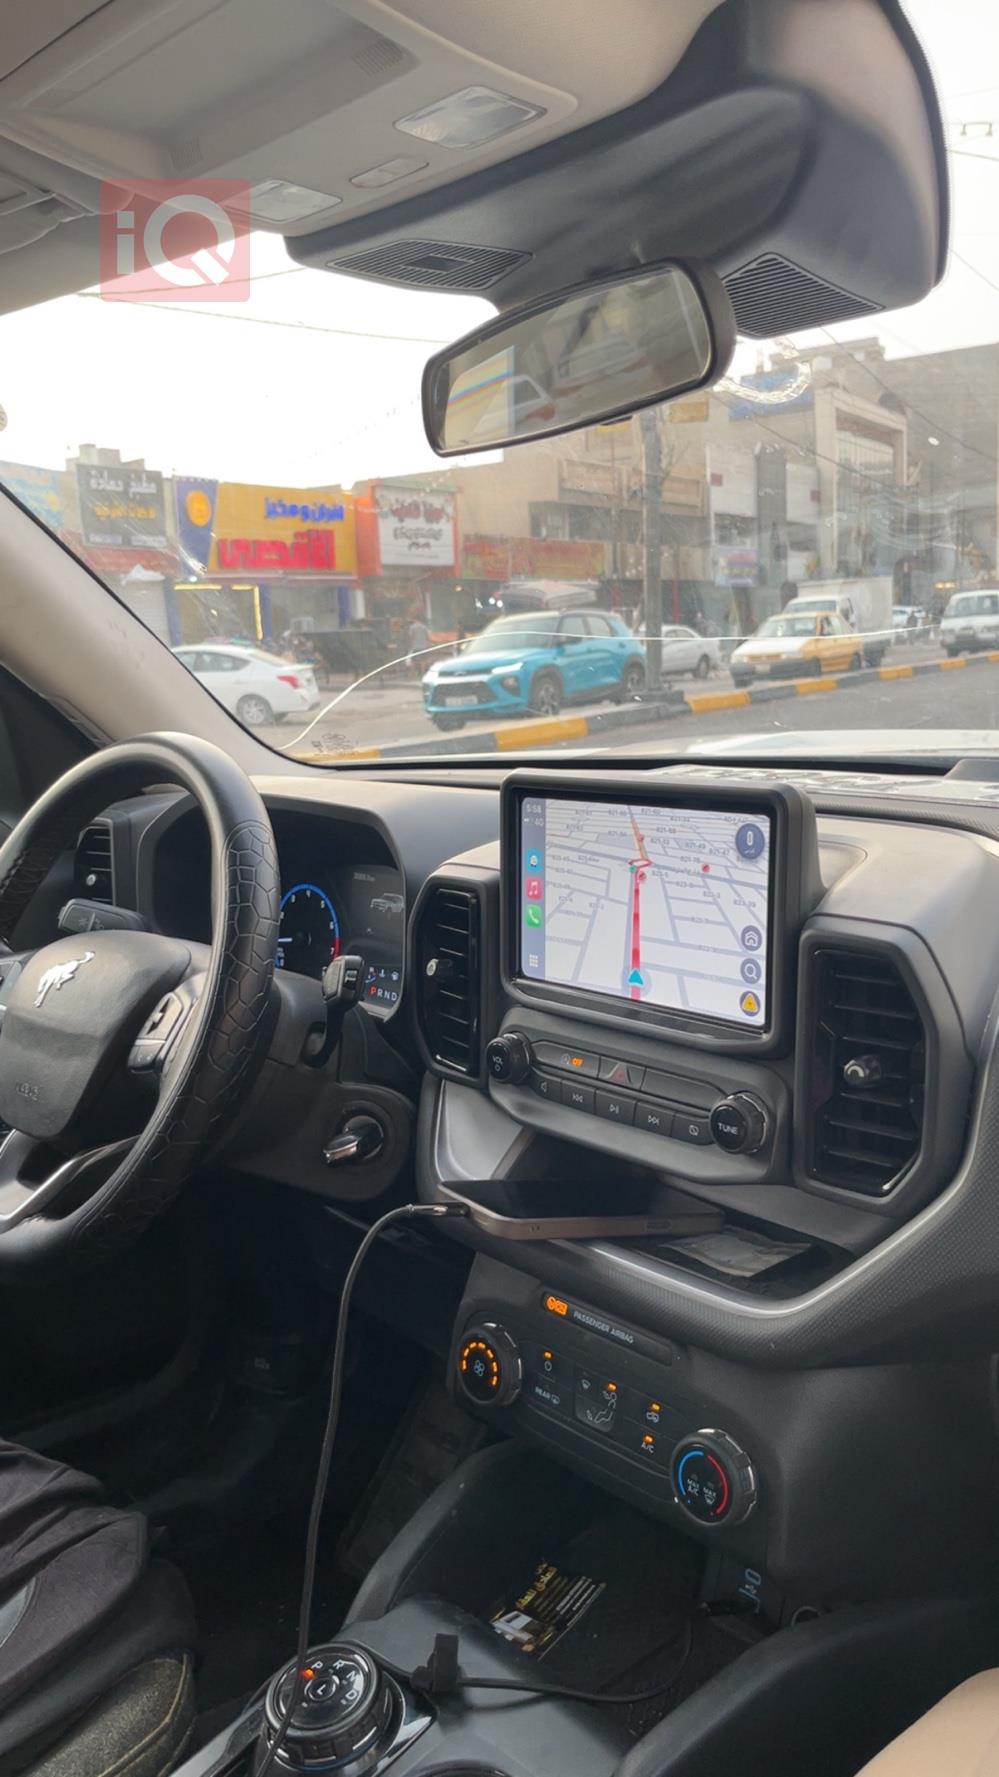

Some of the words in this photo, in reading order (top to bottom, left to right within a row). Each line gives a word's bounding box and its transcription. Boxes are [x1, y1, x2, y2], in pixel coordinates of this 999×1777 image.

[370, 985, 378, 996] P
[377, 988, 384, 998] R
[384, 990, 391, 1000] N
[391, 992, 398, 1001] D
[492, 1056, 503, 1065] VOL
[718, 1122, 738, 1135] TUNE
[573, 1310, 610, 1333] PASSENGER
[610, 1328, 635, 1344] AIRBAG
[535, 1386, 551, 1398] REAR
[641, 1441, 655, 1454] A/C
[687, 1478, 700, 1489] MAX
[688, 1485, 699, 1497] A/C
[703, 1487, 717, 1498] MAX
[310, 1660, 323, 1669] P
[333, 1659, 345, 1669] R
[346, 1670, 358, 1681] N
[316, 1684, 326, 1695] L
[345, 1689, 358, 1700] D
